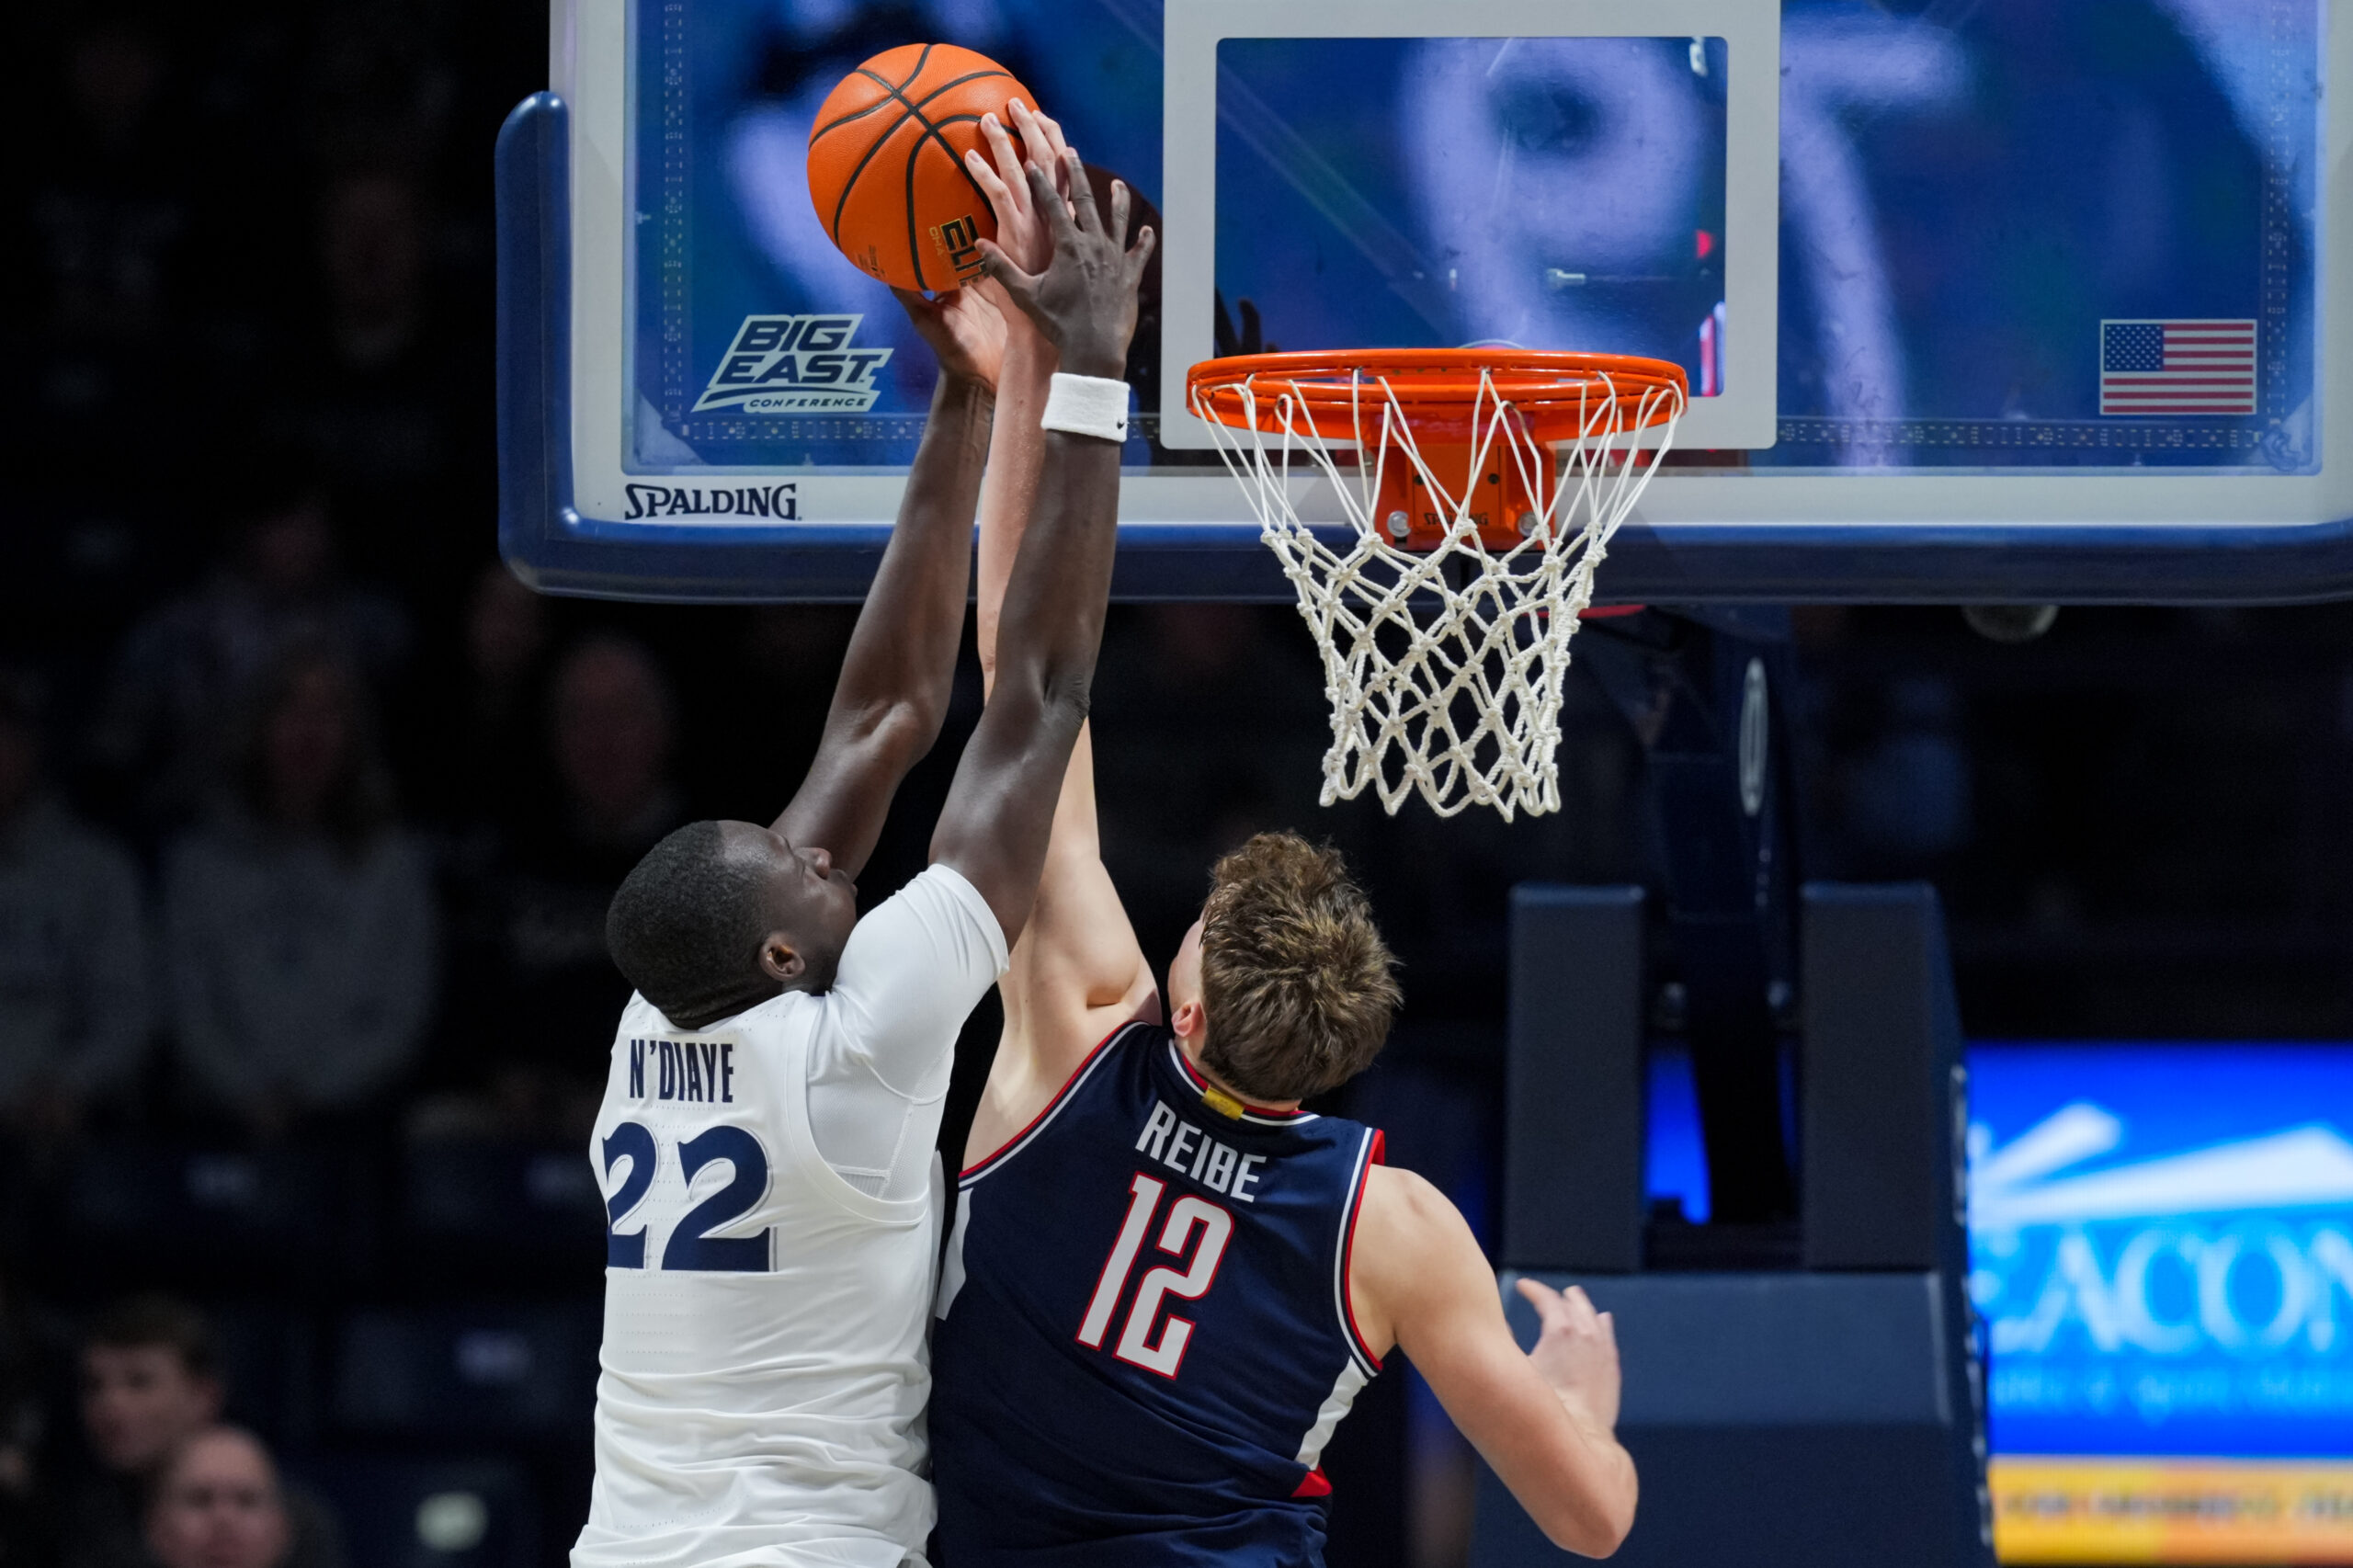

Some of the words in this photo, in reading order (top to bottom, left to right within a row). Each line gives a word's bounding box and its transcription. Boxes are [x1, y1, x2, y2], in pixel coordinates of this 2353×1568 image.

[734, 320, 853, 352] BIG
[716, 354, 883, 384] EAST
[749, 397, 868, 408] CONFERENCE
[624, 483, 796, 521] SPALDING
[1135, 1099, 1267, 1203] REIBE
[602, 1121, 778, 1272] 22
[1074, 1170, 1235, 1381] 12
